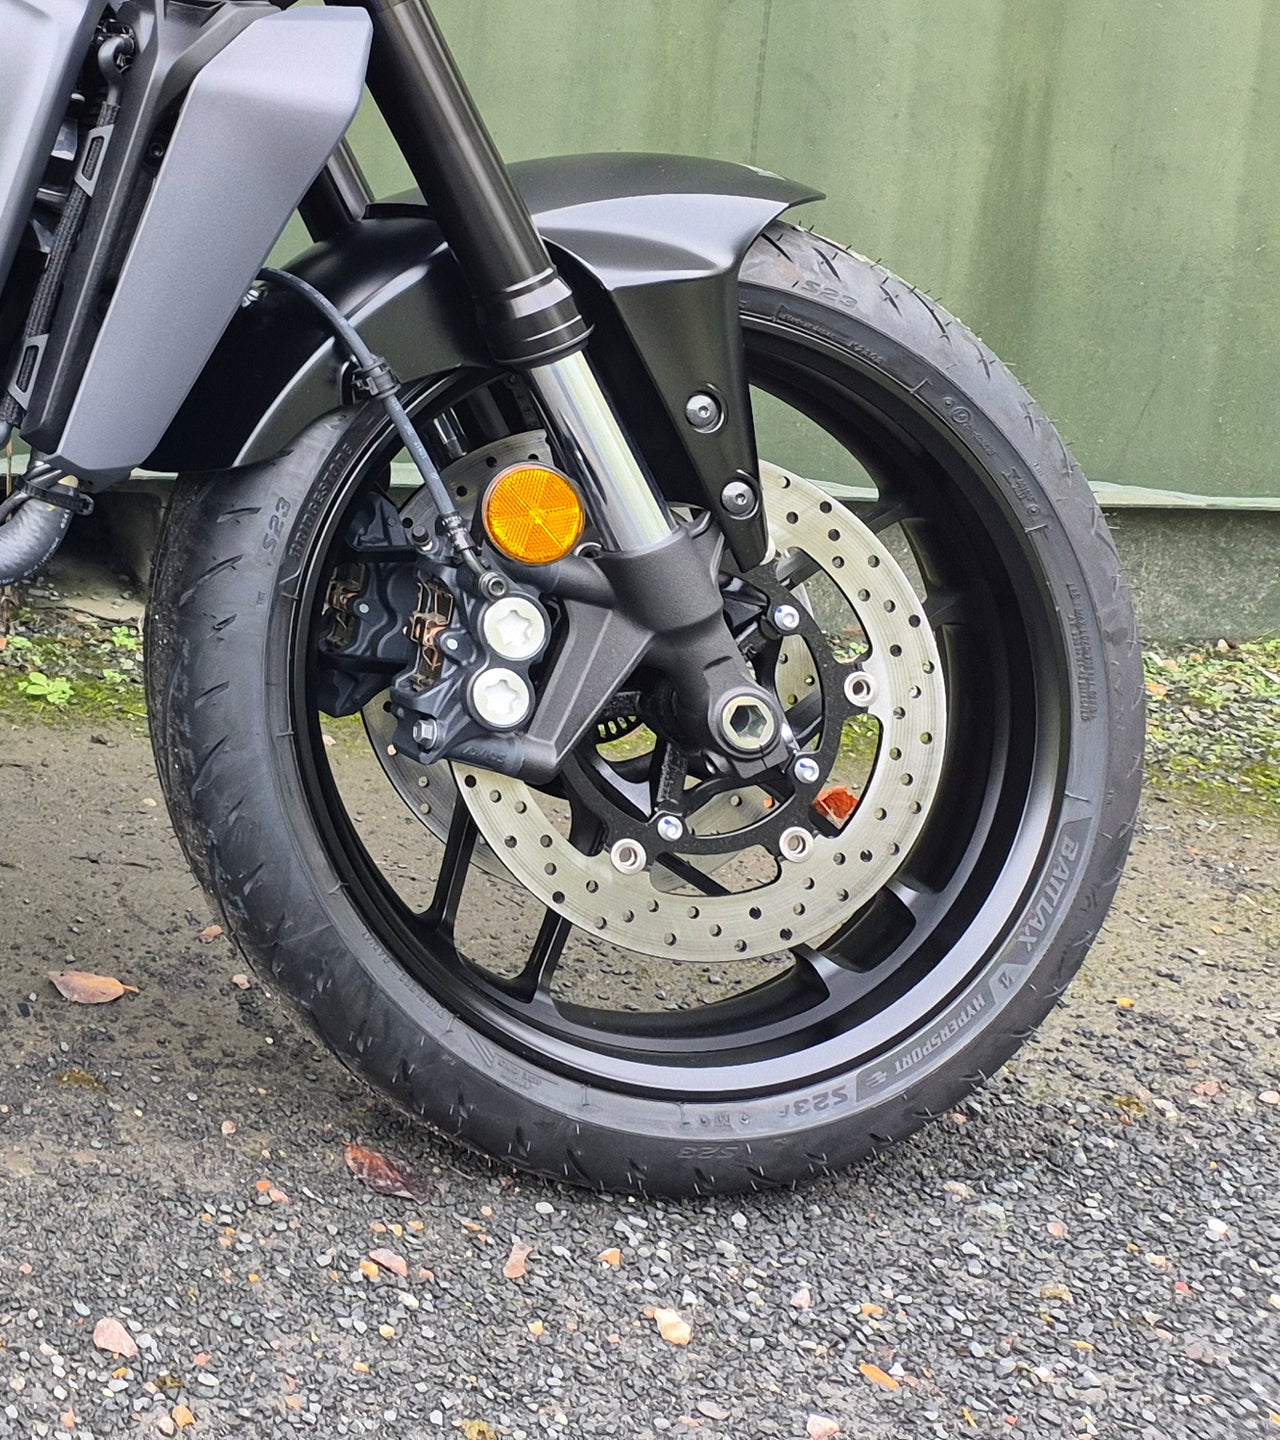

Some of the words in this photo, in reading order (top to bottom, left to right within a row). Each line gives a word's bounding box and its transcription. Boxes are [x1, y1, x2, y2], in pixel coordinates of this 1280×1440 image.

[802, 280, 858, 309] S23
[262, 496, 291, 556] S23
[1017, 836, 1079, 952] BATTLAX
[892, 993, 986, 1075] HYPERSPORT
[677, 1146, 739, 1160] S23
